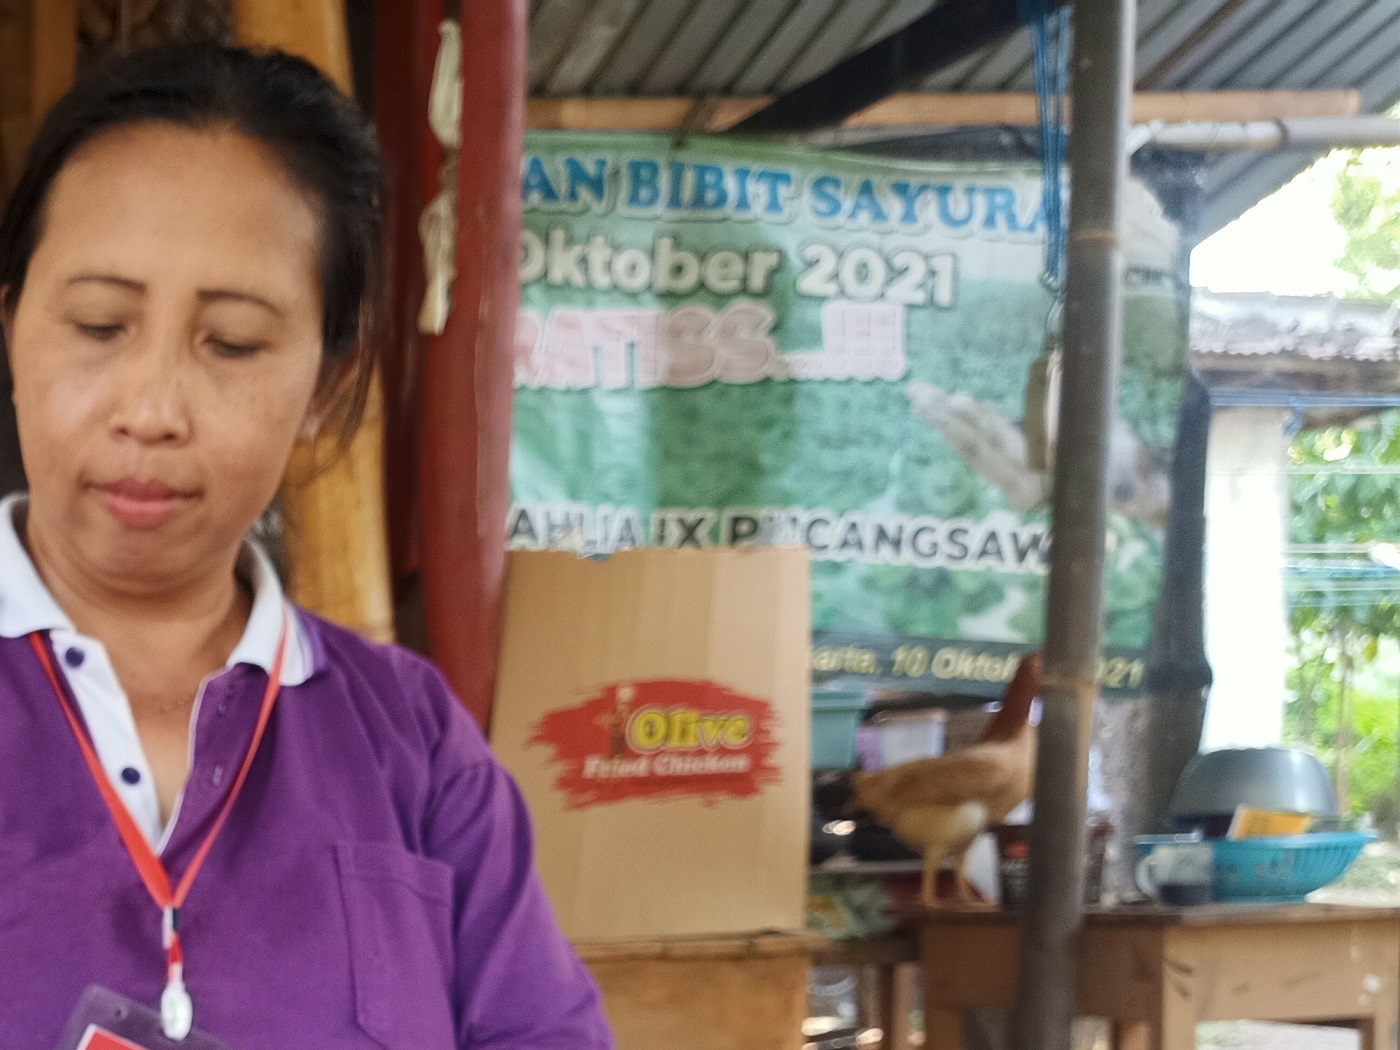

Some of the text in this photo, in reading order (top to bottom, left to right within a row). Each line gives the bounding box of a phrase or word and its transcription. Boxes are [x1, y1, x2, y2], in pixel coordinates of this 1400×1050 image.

[627, 160, 792, 214] BIBIT
[811, 177, 1068, 234] SAYURA
[797, 244, 956, 306] 2021
[633, 710, 750, 748] Olive
[651, 754, 750, 776] Chicken
